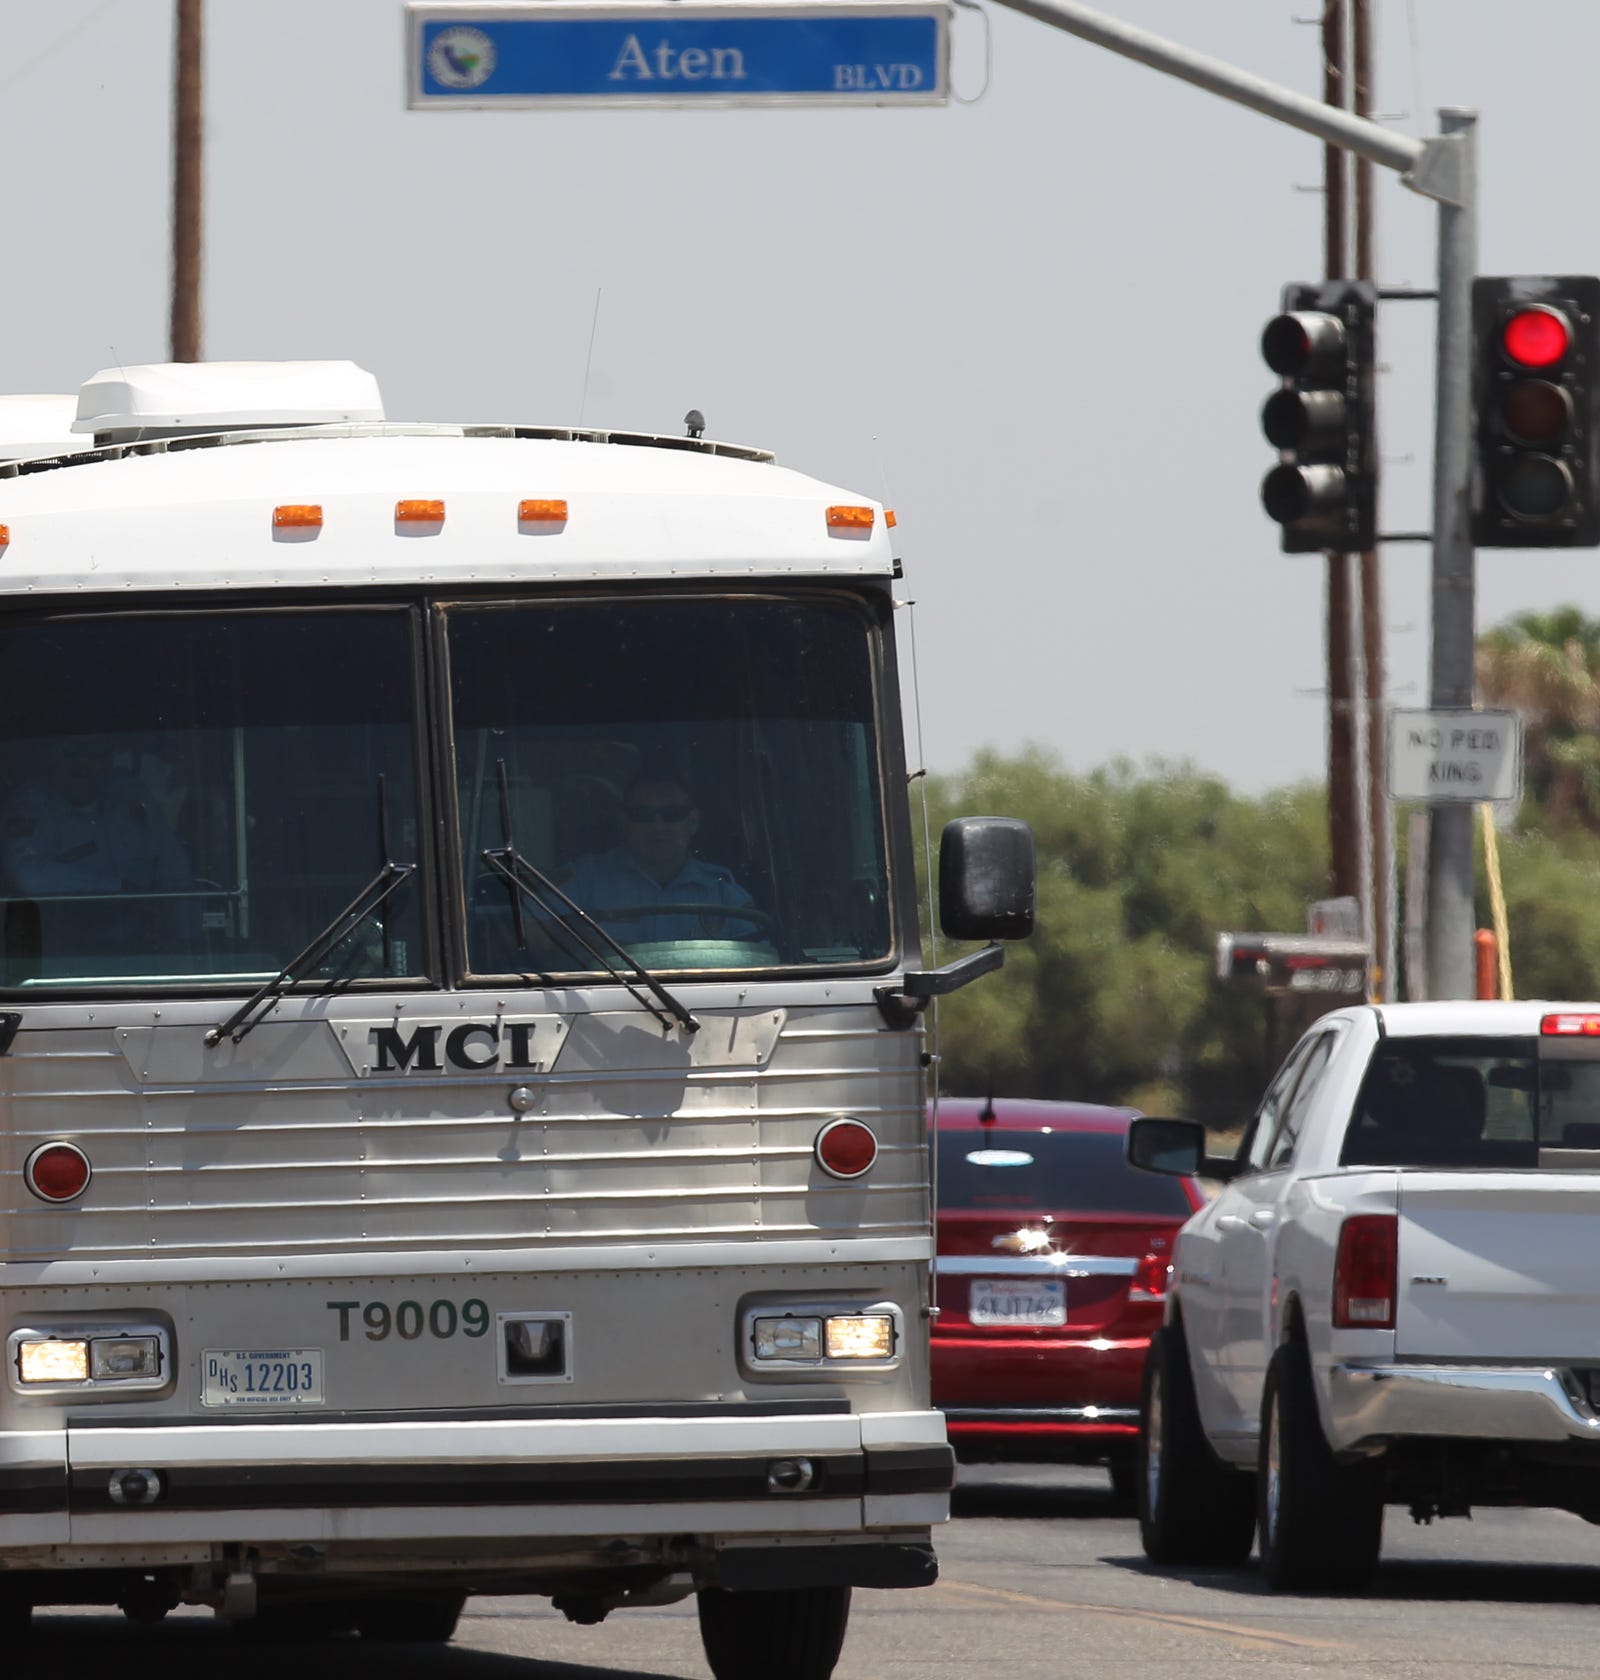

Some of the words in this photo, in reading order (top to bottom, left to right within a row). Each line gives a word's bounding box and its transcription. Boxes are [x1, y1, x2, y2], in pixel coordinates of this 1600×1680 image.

[608, 34, 745, 80] Aten
[834, 64, 922, 90] BLVD
[1407, 729, 1442, 750] NO
[1451, 728, 1500, 750] PED
[369, 1022, 537, 1071] MCI
[327, 1298, 490, 1341] T9009
[245, 1363, 313, 1392] 12203
